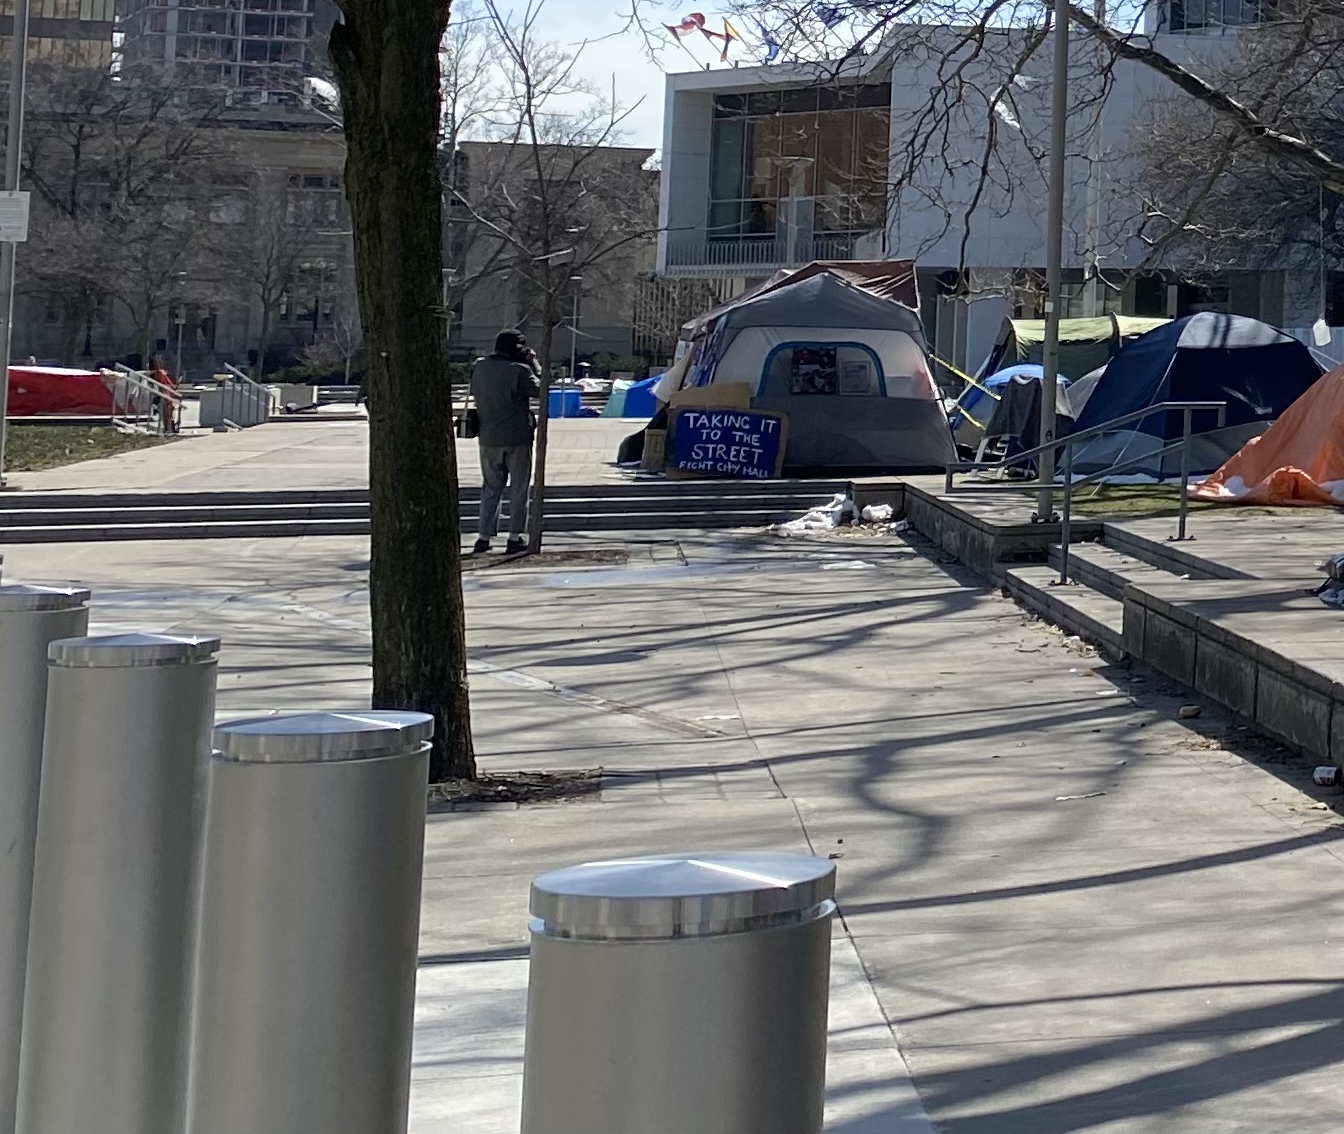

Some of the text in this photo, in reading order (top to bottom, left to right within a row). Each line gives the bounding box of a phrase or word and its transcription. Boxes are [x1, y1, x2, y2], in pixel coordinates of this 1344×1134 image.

[683, 412, 777, 434] TAKING IT
[700, 428, 761, 446] TO THE
[691, 443, 764, 465] STREET
[679, 460, 714, 471] FIGHT
[742, 466, 769, 479] HALL
